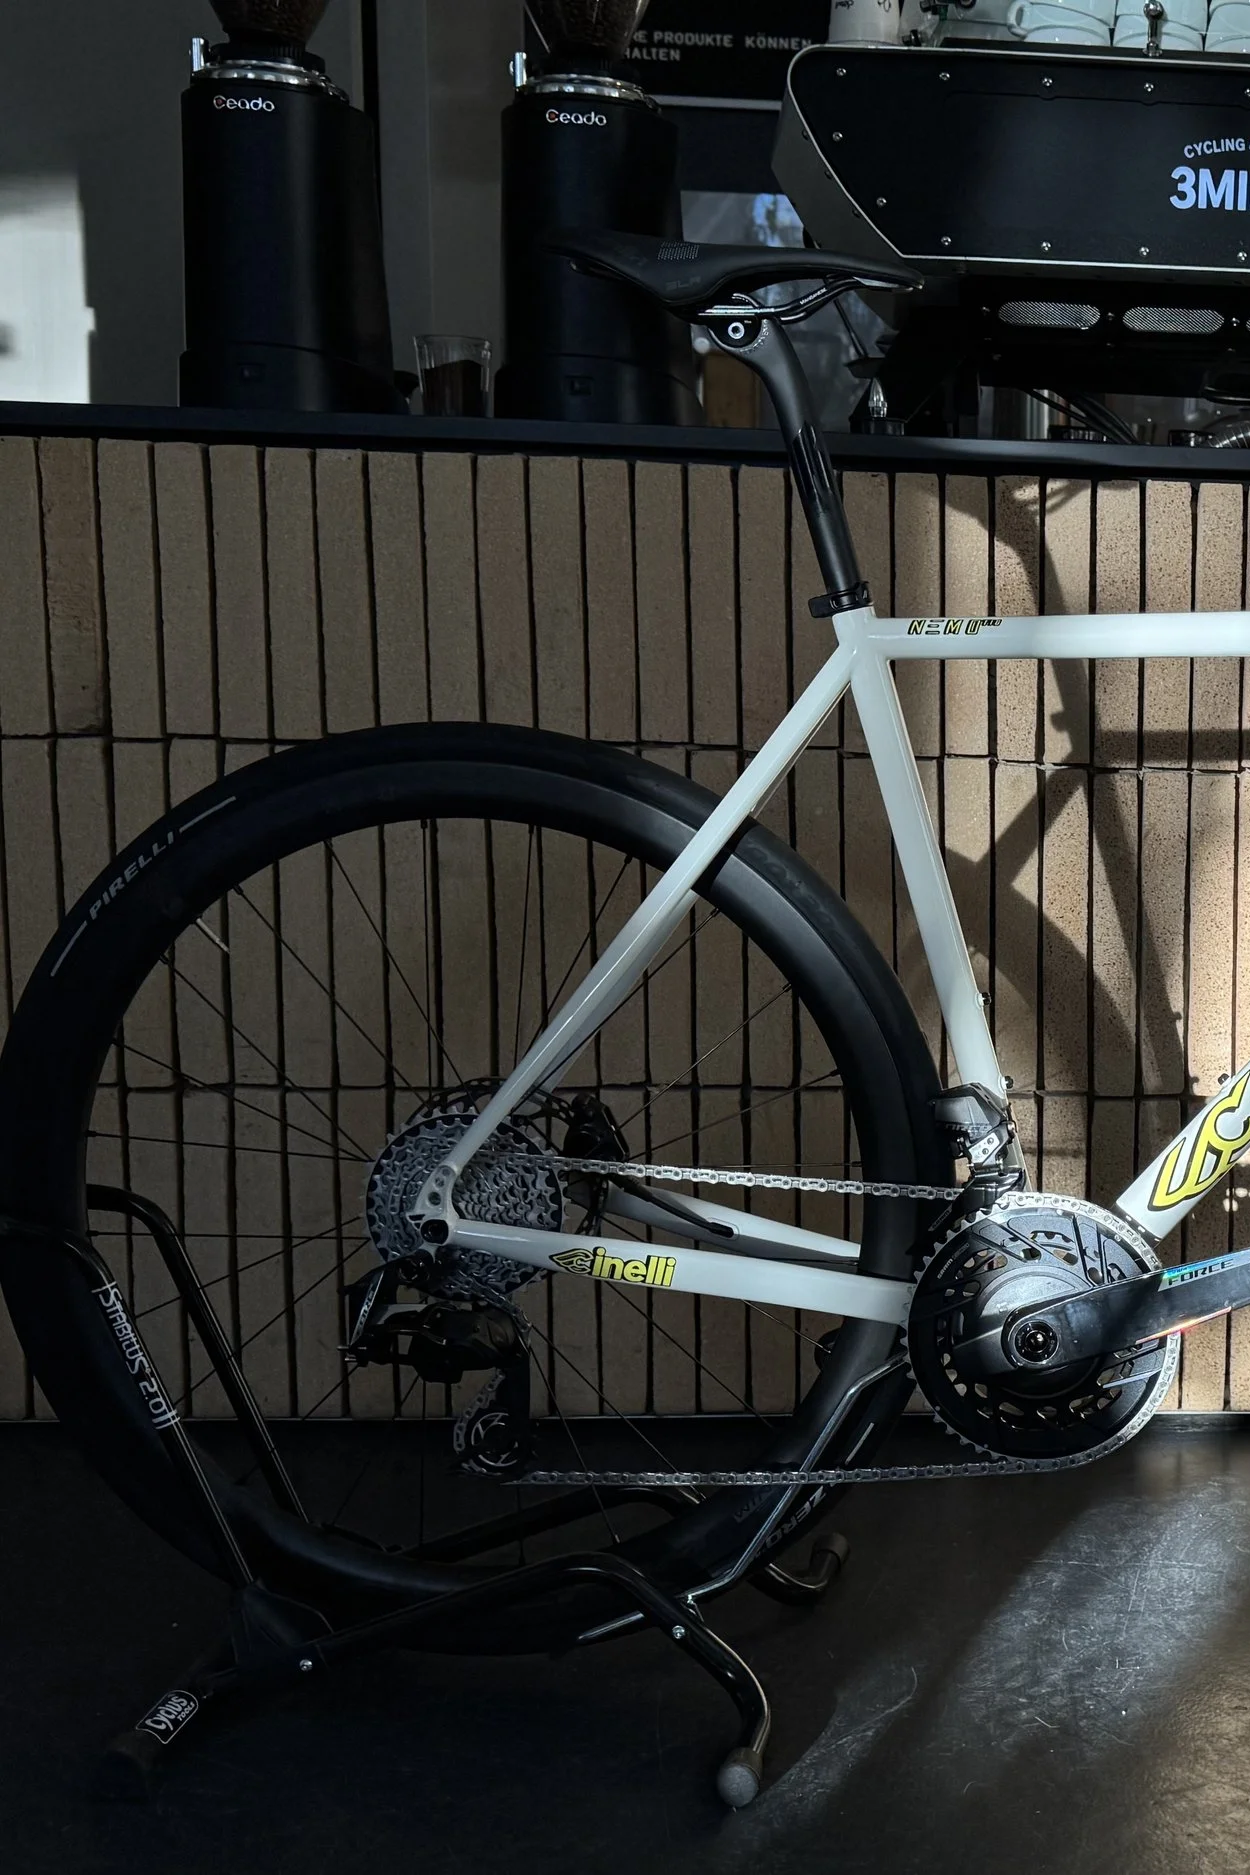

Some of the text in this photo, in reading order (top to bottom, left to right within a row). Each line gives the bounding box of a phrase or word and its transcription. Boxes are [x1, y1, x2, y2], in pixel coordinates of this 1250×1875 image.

[653, 30, 734, 48] PRODUKTE
[744, 31, 812, 50] KÖNNEN
[213, 95, 275, 112] Ceado
[545, 109, 607, 126] Ceado
[1183, 138, 1246, 159] CYCLING
[89, 831, 175, 921] PIRELLI
[1167, 1259, 1235, 1286] FORCE
[138, 1377, 167, 1415] 2.0
